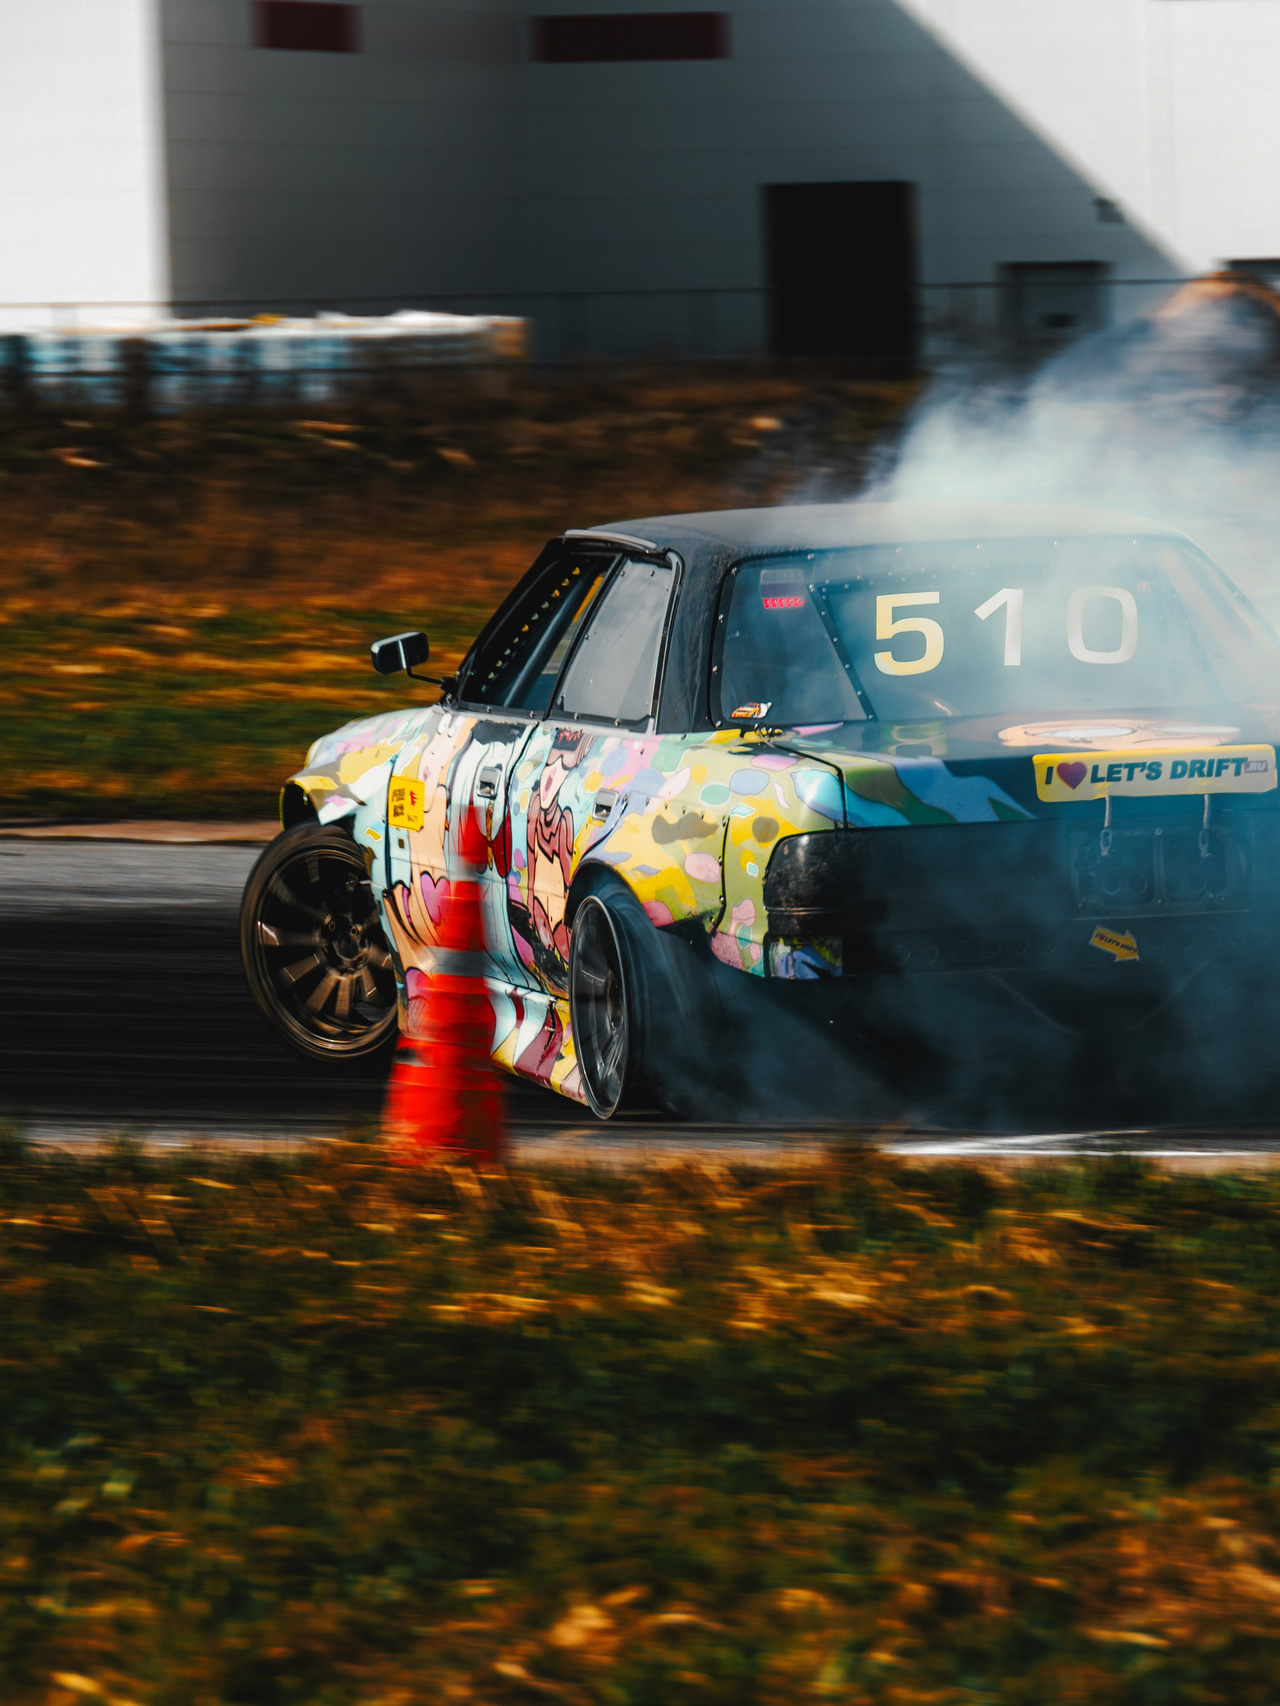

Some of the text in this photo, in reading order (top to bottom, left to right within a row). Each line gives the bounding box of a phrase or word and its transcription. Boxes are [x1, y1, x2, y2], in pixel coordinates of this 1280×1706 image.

[874, 586, 1139, 677] 510
[1045, 765, 1055, 785] I
[1090, 761, 1163, 784] LET'S
[1170, 757, 1248, 780] DRIFT
